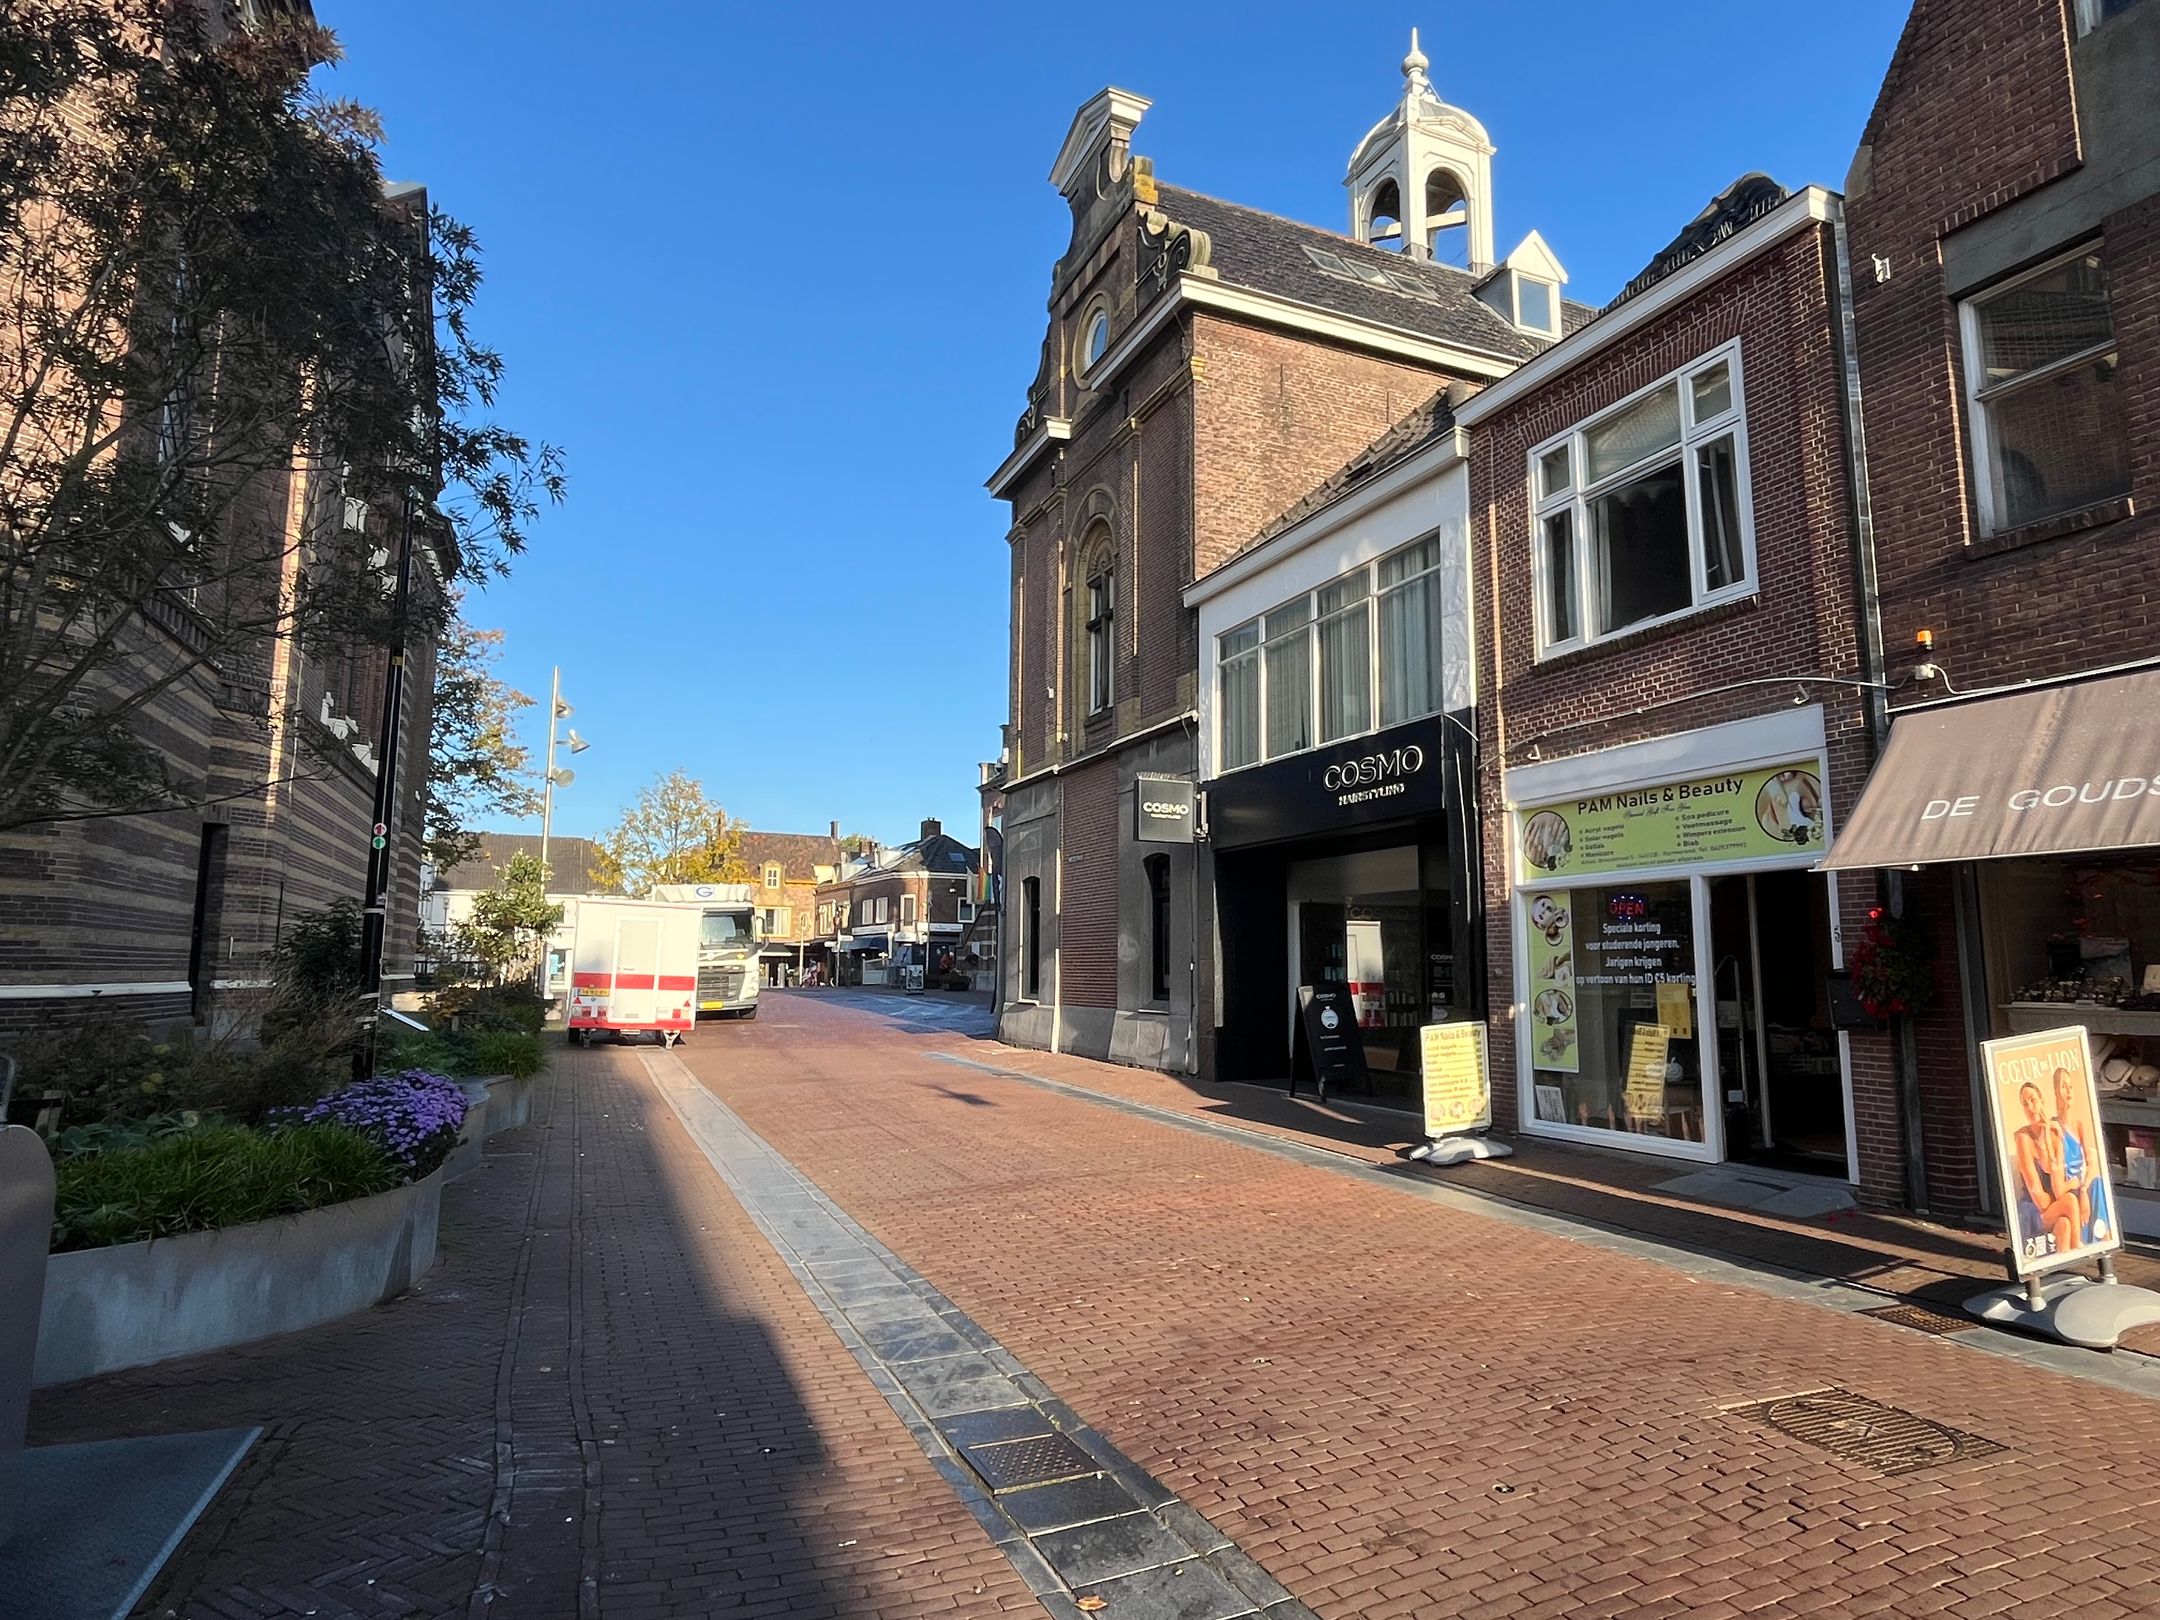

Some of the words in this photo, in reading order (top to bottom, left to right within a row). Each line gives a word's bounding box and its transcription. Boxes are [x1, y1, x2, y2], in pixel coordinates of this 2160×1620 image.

[1323, 745, 1424, 792] COSMO
[1338, 782, 1405, 806] HAIRSTYLING
[1578, 797, 1612, 815] PAM
[1617, 791, 1658, 809] Nails
[1662, 787, 1674, 801] &
[1679, 778, 1744, 800] Beauty
[1143, 801, 1189, 815] COSMO
[1697, 809, 1729, 819] pedicure
[1920, 795, 1980, 820] DE
[1609, 902, 1644, 915] OPEN
[1602, 923, 1633, 936] Speciale
[1634, 922, 1661, 935] korting
[1584, 941, 1600, 951] voor
[1602, 939, 1642, 950] studerende
[1642, 938, 1680, 951] jongeren.
[1605, 957, 1634, 970] Jarigen
[1634, 956, 1662, 969] krijgen
[1576, 975, 1585, 987] op
[1585, 975, 1614, 985] vertoon
[1614, 975, 1628, 984] van
[1629, 973, 1644, 984] hun
[1644, 973, 1653, 984] ID
[1654, 972, 1665, 985] €5
[1666, 972, 1696, 986] korting
[2047, 1047, 2080, 1073] LION
